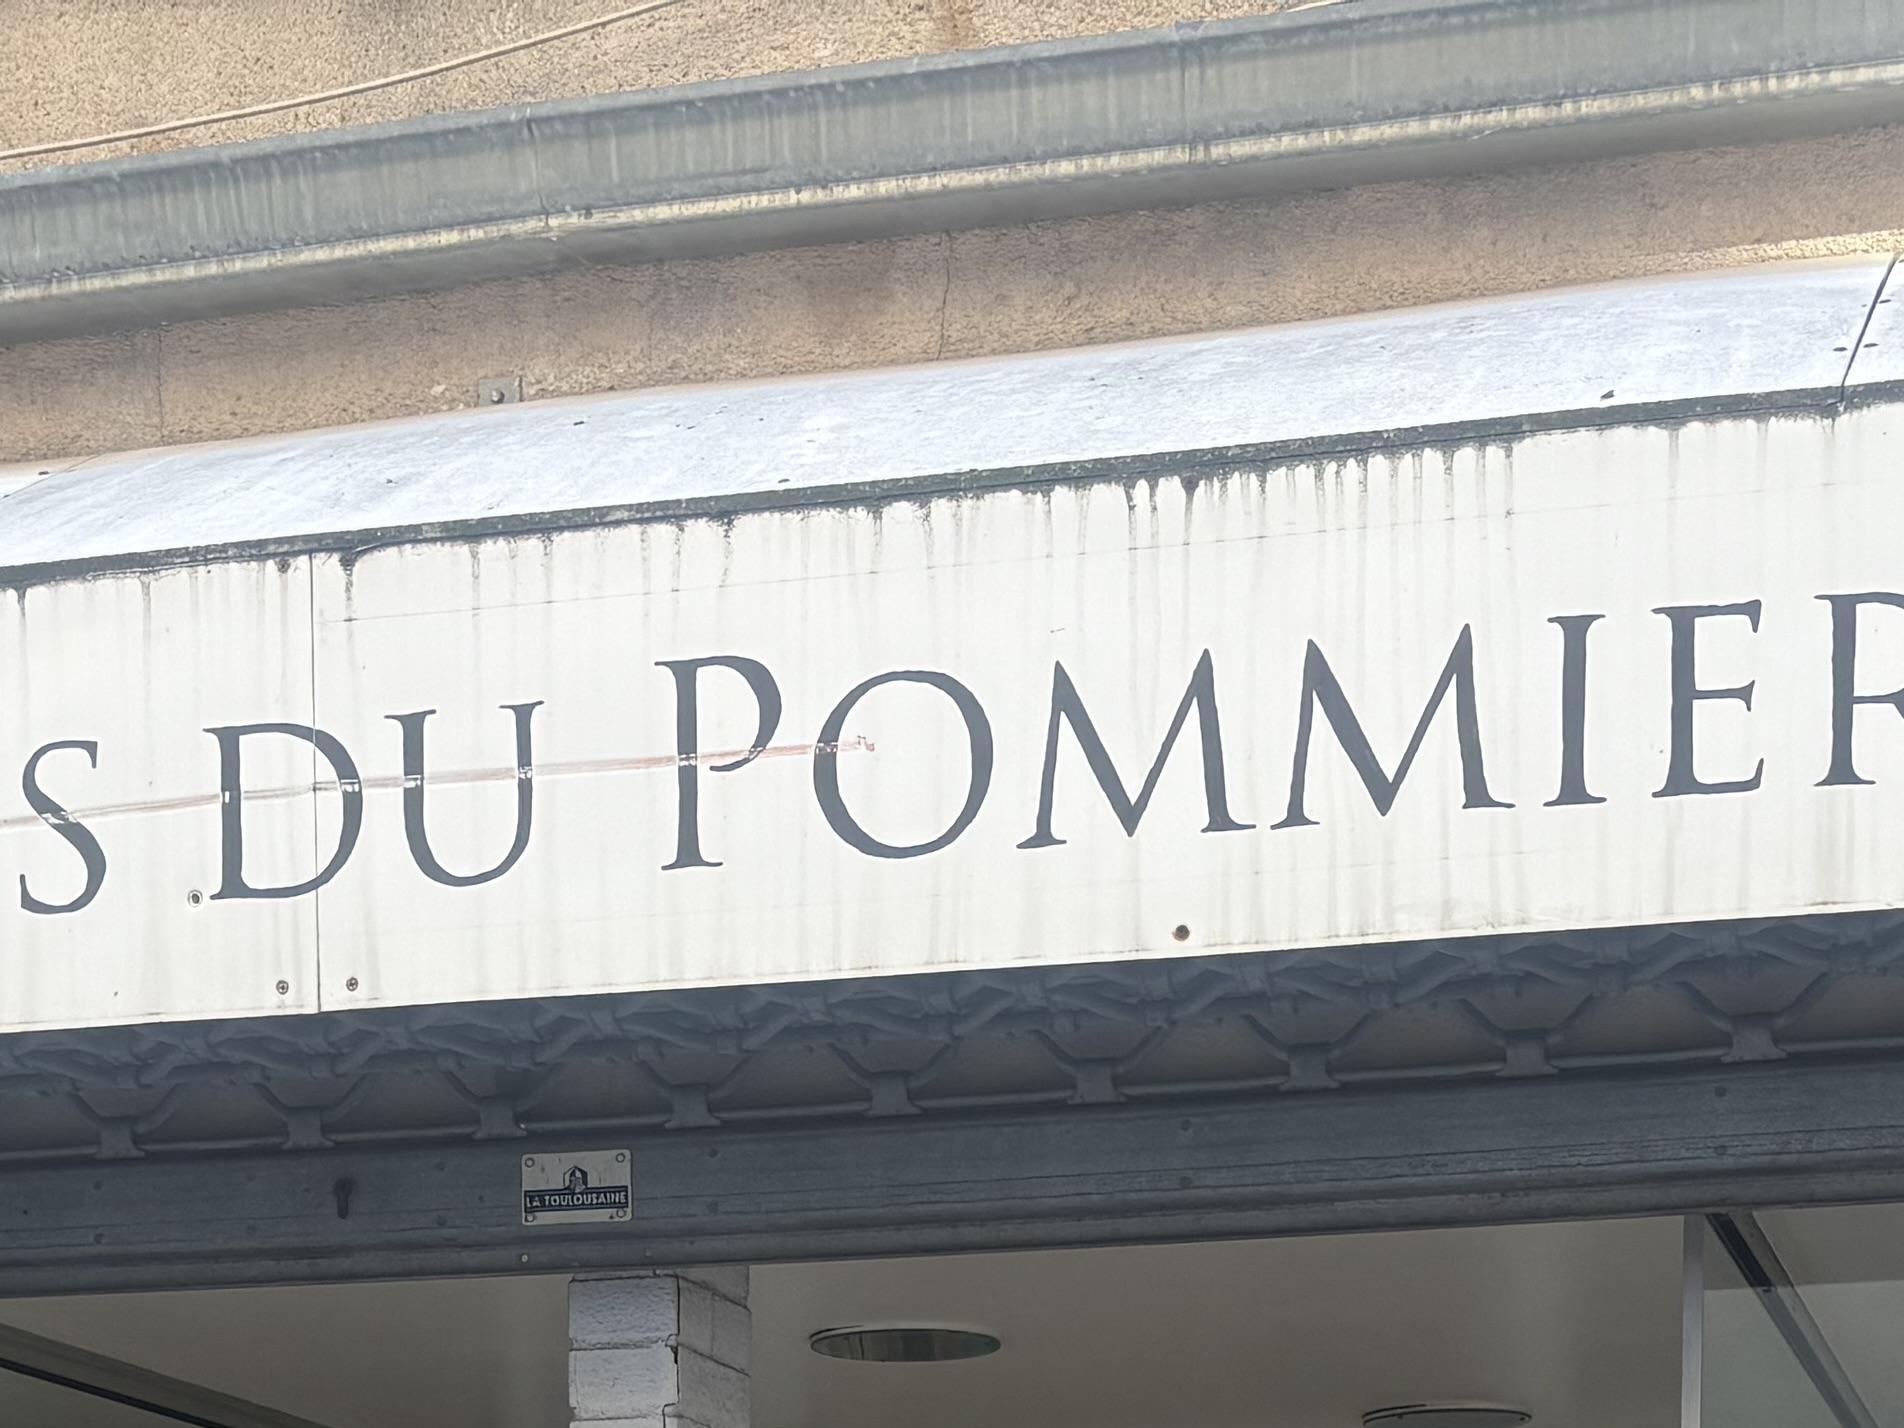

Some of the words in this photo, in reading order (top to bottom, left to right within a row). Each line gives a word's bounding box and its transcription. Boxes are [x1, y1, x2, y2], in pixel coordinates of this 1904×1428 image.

[203, 701, 544, 900] DU
[527, 1198, 541, 1207] LA
[544, 1191, 626, 1206] TOULOUSAINE
